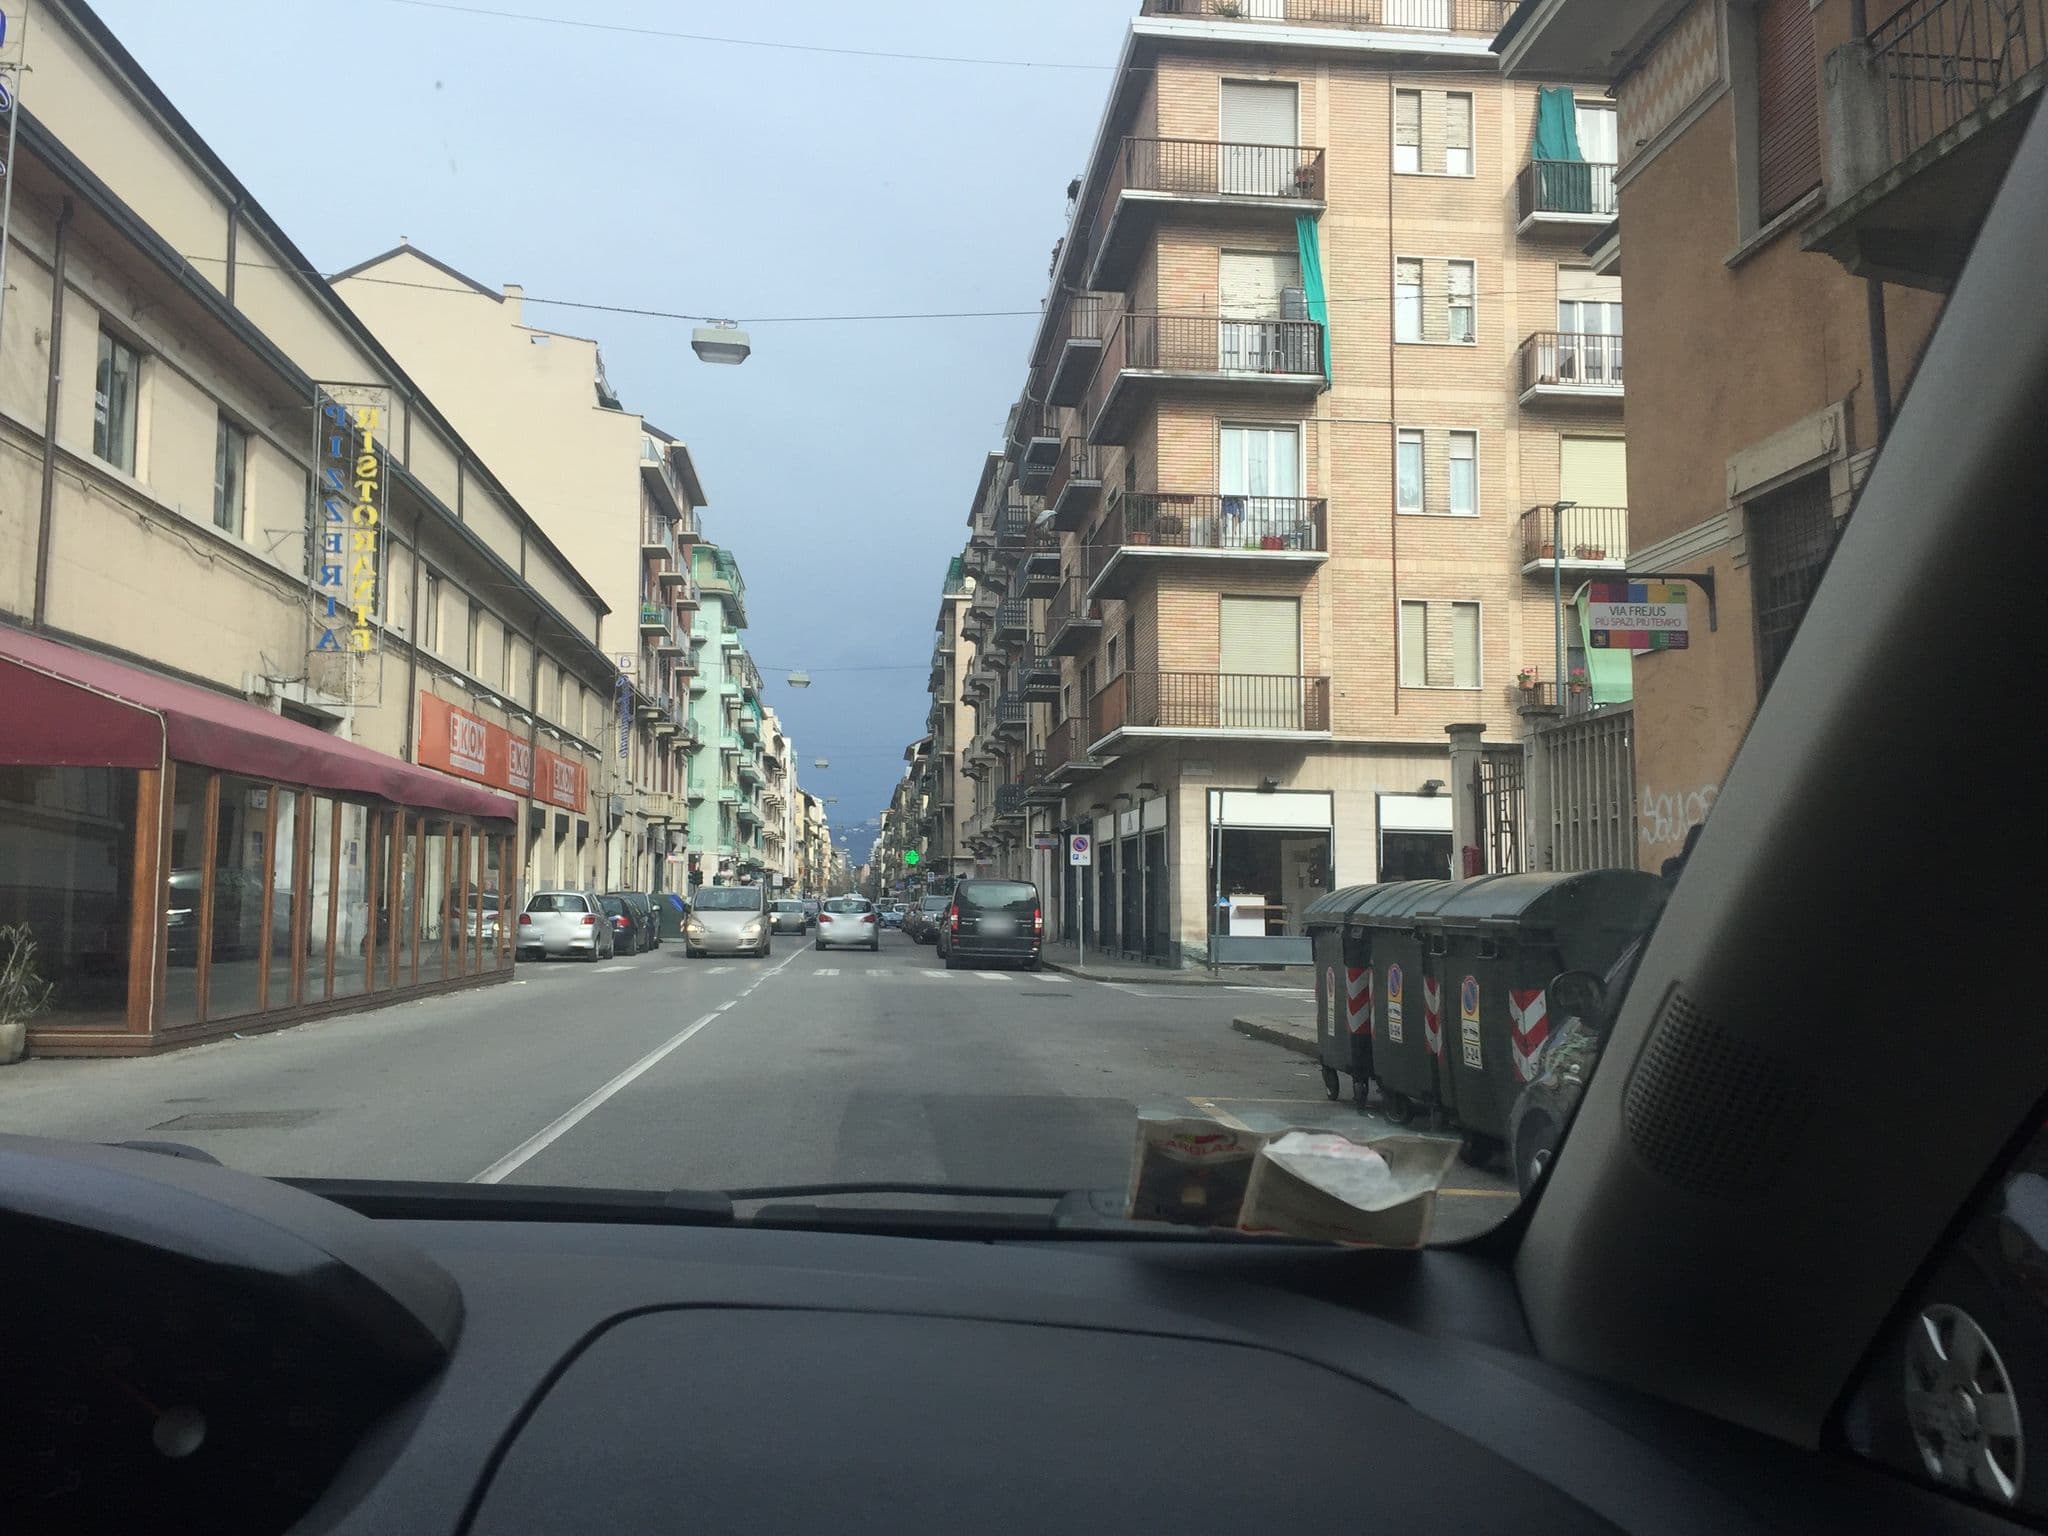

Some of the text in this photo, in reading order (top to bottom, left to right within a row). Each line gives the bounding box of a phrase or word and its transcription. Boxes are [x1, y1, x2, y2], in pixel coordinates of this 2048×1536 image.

[1609, 606, 1666, 617] VIA FREJUS
[510, 740, 532, 777] EKO
